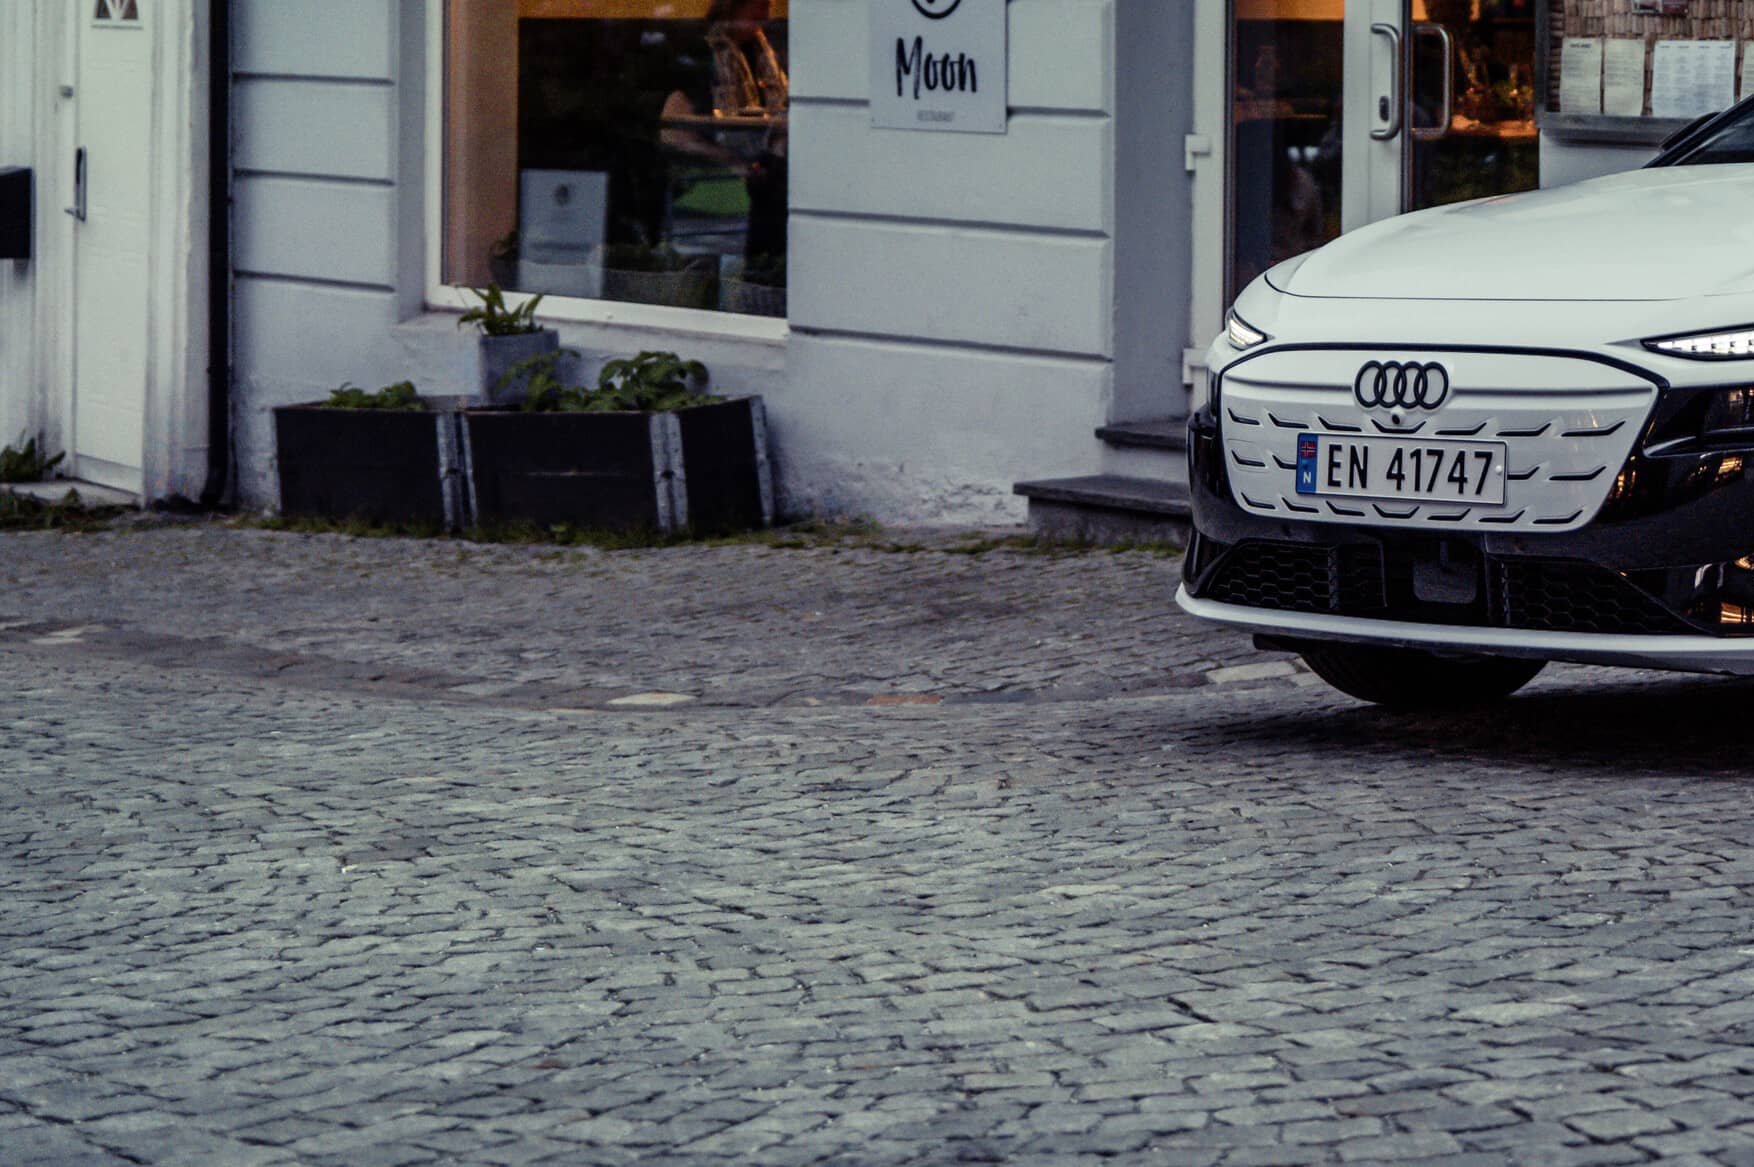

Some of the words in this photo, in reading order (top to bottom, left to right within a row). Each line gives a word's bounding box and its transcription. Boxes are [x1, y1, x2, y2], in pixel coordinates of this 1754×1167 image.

[896, 35, 978, 100] Moon
[1302, 470, 1312, 484] N
[1327, 443, 1369, 489] EN
[1386, 447, 1494, 496] 41747
